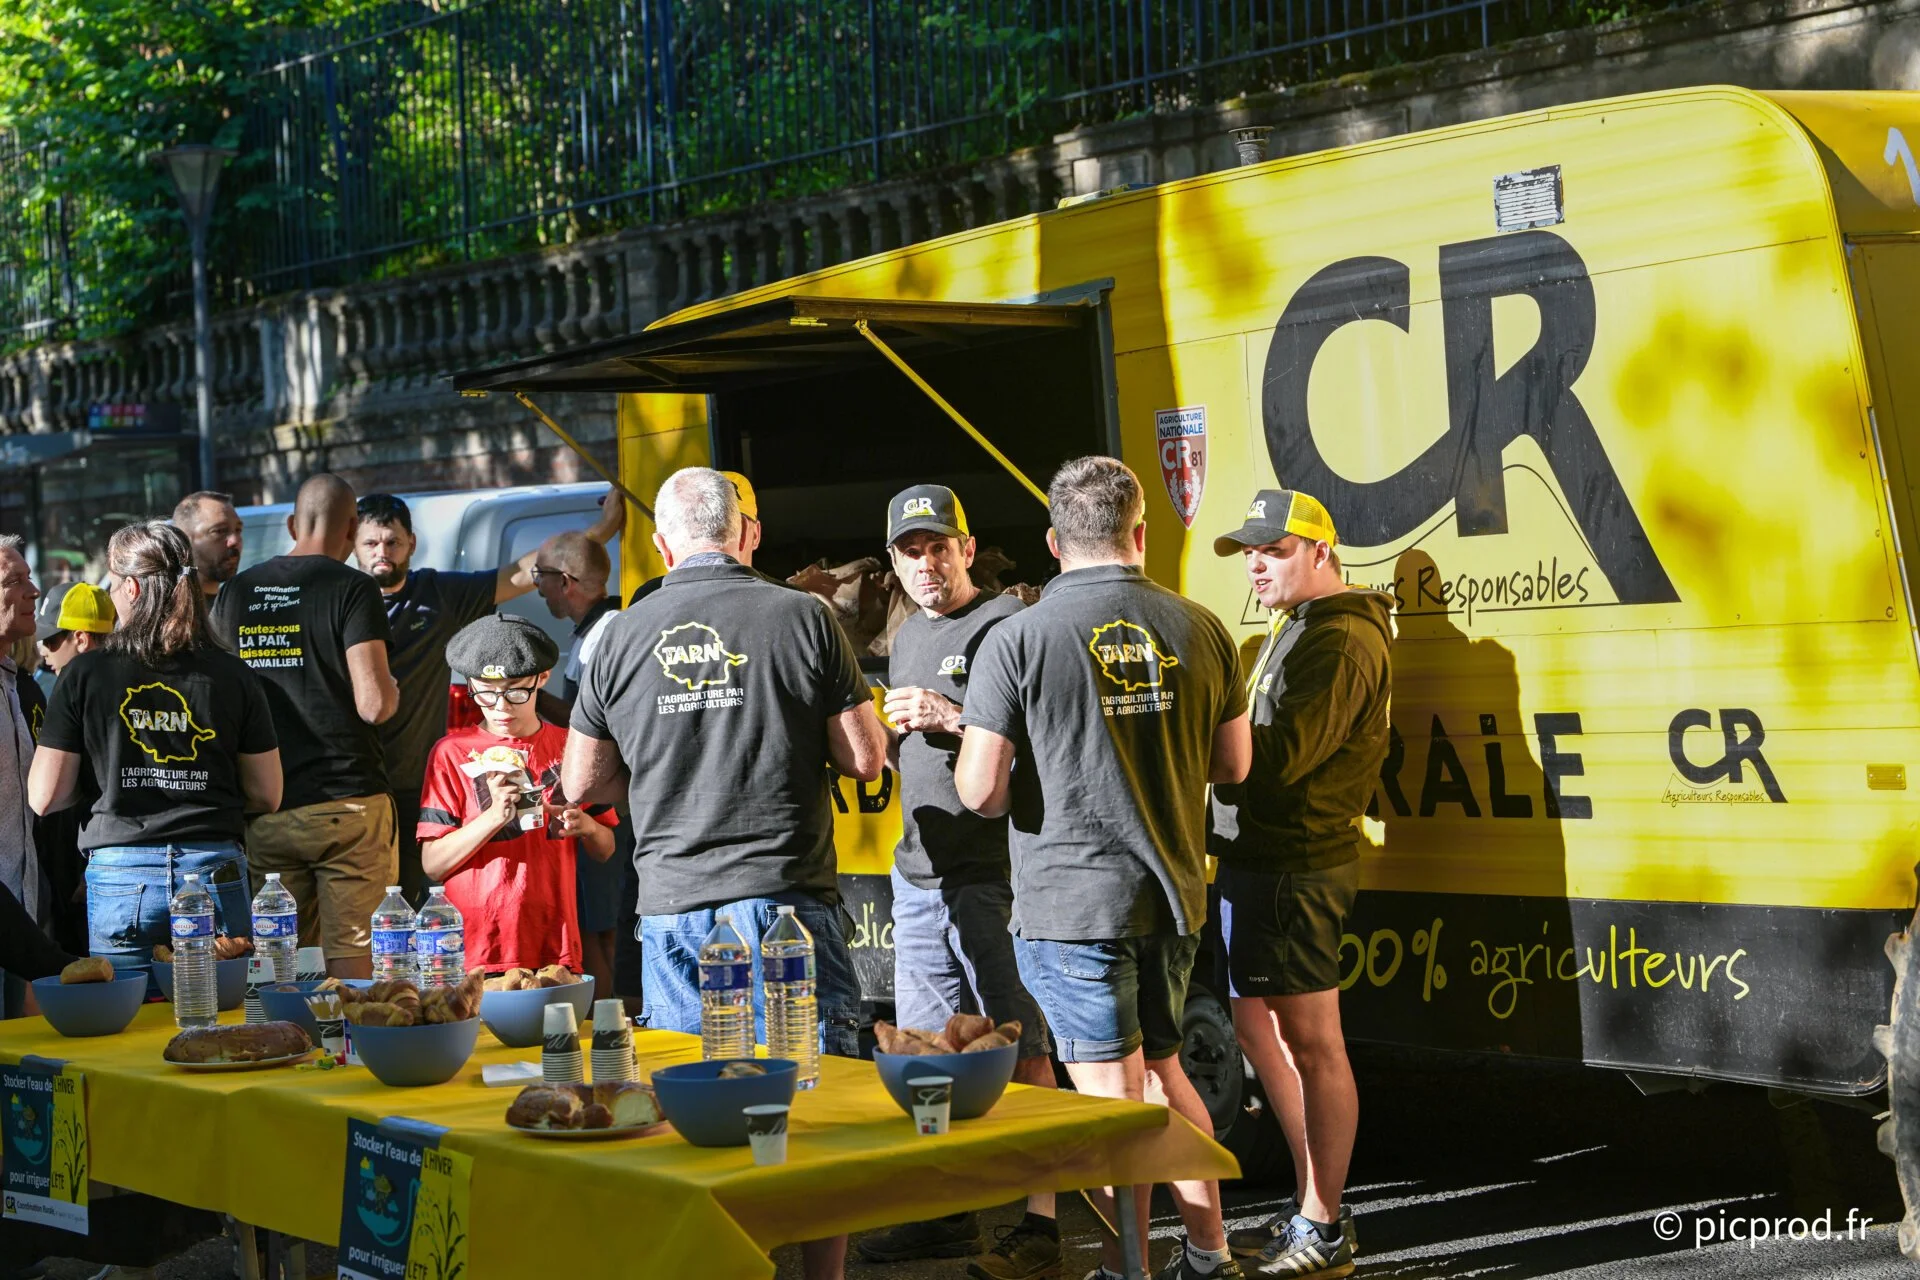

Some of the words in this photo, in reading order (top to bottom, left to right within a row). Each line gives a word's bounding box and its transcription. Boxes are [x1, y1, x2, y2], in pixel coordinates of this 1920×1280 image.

[1160, 412, 1203, 425] AGRICULTURE
[1262, 230, 1681, 604] CR
[1160, 423, 1203, 438] NATIONALE
[1161, 440, 1192, 470] CR
[1191, 450, 1203, 467] 81
[1418, 556, 1589, 627] Responsables
[239, 636, 255, 648] LA
[258, 634, 290, 648] PAIX,
[662, 643, 720, 665] TARN
[1098, 643, 1154, 664] TARN
[245, 657, 298, 669] RAVAILLER
[657, 689, 724, 705] L'AGRICULTURE
[726, 688, 743, 697] PAR
[1101, 692, 1159, 705] L'AGRICULTURE
[659, 704, 675, 715] LES
[678, 697, 743, 712] AGRICULTEURS
[129, 709, 188, 732] TARN
[1668, 708, 1788, 803] CR
[121, 767, 188, 779] L'AGRICULTURE
[190, 770, 208, 780] PAR
[122, 778, 138, 788] LES
[140, 778, 207, 791] AGRICULTEURS
[1666, 789, 1713, 807] Agriculteurs
[1715, 790, 1765, 806] Responsables
[1338, 929, 1403, 990] 00
[1412, 917, 1447, 1002] %
[1471, 921, 1749, 1019] agriculteurs
[3, 1073, 26, 1089] Stocker
[27, 1075, 44, 1091] l'eau
[44, 1078, 53, 1092] de
[353, 1131, 384, 1155] Stocker
[385, 1141, 407, 1163] l'eau
[409, 1150, 421, 1166] de
[9, 1172, 25, 1184] pour
[26, 1171, 50, 1189] irriguer
[348, 1246, 370, 1263] pour
[371, 1250, 405, 1275] irriguer
[1223, 1265, 1239, 1276] NIKE
